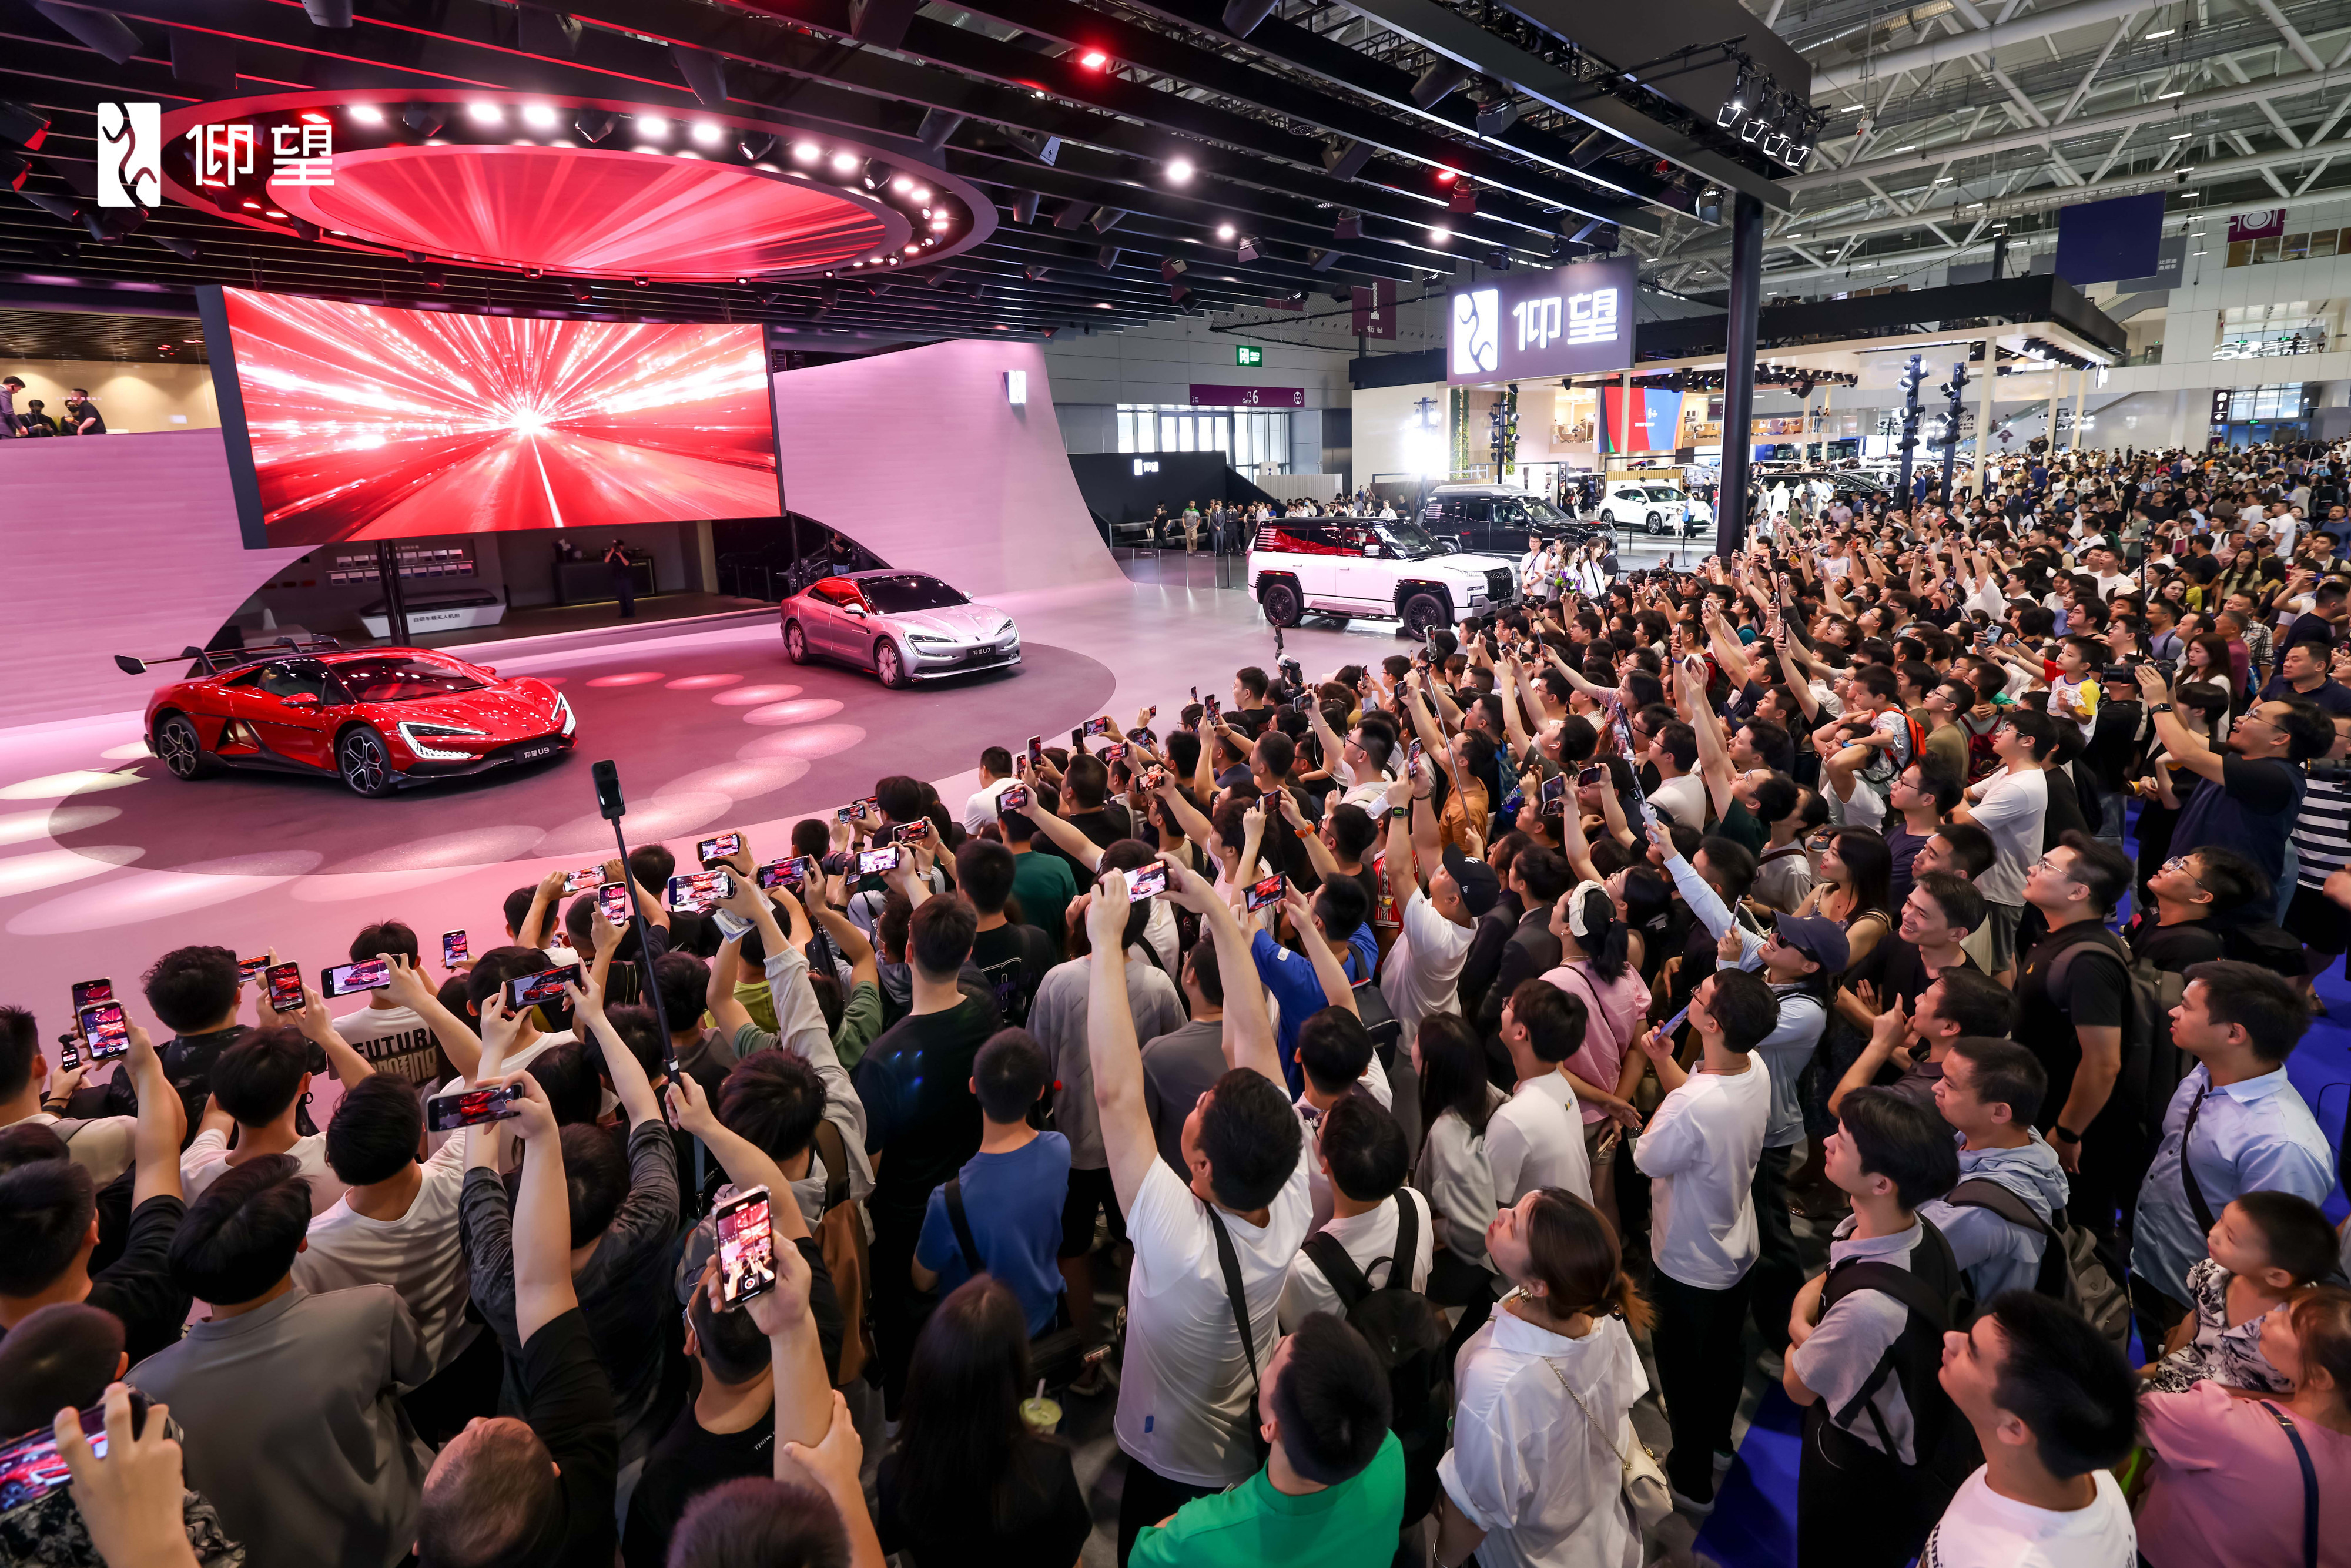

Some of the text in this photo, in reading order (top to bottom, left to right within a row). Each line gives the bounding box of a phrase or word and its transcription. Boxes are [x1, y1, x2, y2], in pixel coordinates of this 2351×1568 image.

[1512, 288, 1618, 351] 仰望
[1252, 390, 1259, 404] 6
[352, 1027, 434, 1058] FUTUR
